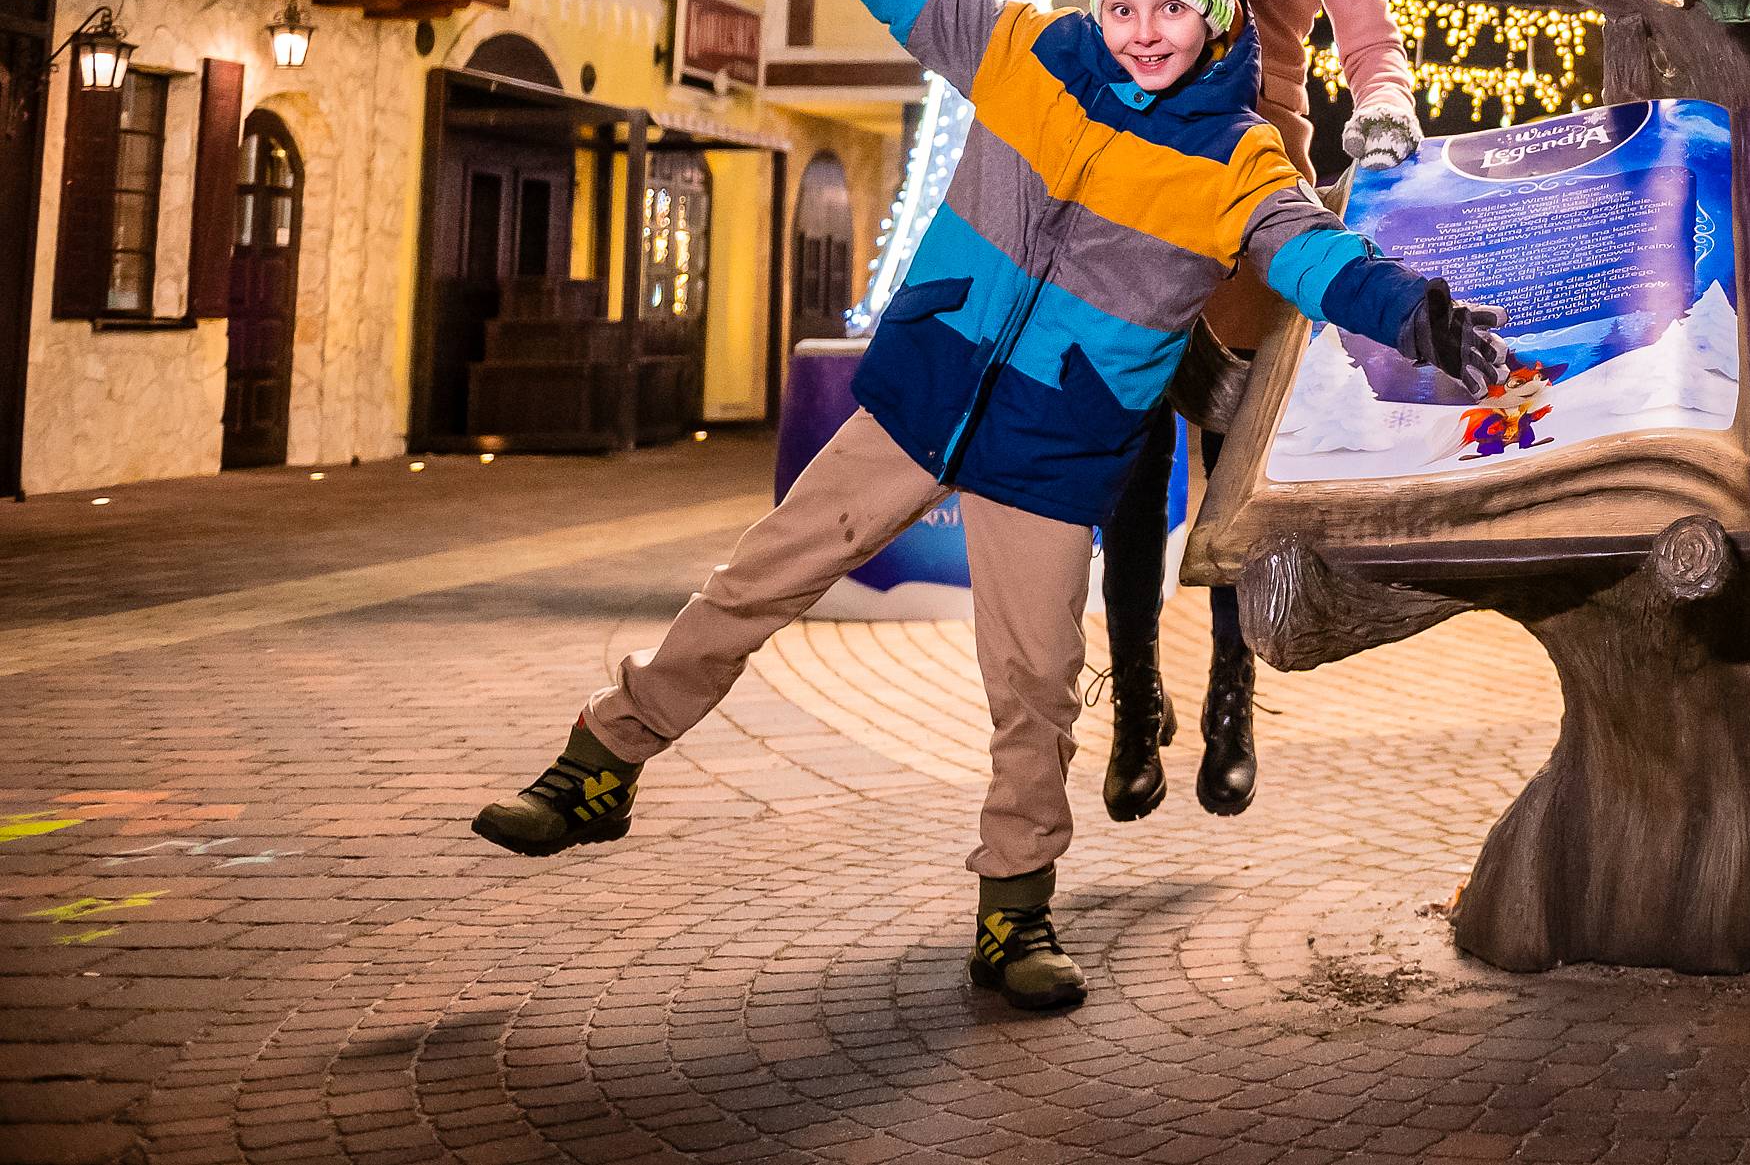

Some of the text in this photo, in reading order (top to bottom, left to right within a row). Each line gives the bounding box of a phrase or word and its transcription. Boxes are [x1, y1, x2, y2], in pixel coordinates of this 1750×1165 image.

[1515, 125, 1574, 142] Winter
[1462, 203, 1507, 215] Witajcie
[1522, 194, 1559, 205] Winter
[1600, 196, 1630, 205] wiele
[1427, 235, 1482, 248] magiczną
[1486, 228, 1522, 239] bramą
[1525, 217, 1580, 231] zostawcie
[1583, 206, 1637, 221] wszystkie
[1435, 222, 1462, 230] Czas
[1481, 211, 1526, 223] zabawie
[1530, 204, 1560, 214] Wam
[1486, 223, 1517, 233] Wam
[1520, 218, 1548, 227] będą
[1551, 210, 1590, 221] drodzy
[1403, 248, 1436, 256] Niech
[1439, 241, 1485, 254] podczas
[1487, 232, 1532, 245] zabawy
[1554, 218, 1607, 232] marszczą
[1421, 255, 1468, 266] naszymi
[1471, 244, 1528, 259] Skrzatami
[1591, 229, 1610, 237] ma
[1575, 240, 1616, 252] sobota,
[1441, 262, 1464, 271] gdy
[1466, 257, 1498, 267] pada,
[1580, 234, 1615, 245] taniec
[1464, 274, 1502, 284] śmiało
[1518, 265, 1544, 276] głąb
[1547, 258, 1582, 269] naszej
[1585, 247, 1634, 261] zimowej
[1637, 243, 1675, 251] krainy,
[1444, 271, 1485, 281] aruzele
[1494, 263, 1526, 275] psoty
[1529, 255, 1569, 267] zawsze
[1572, 250, 1592, 260] jest
[1467, 279, 1505, 290] chwilę
[1508, 273, 1535, 283] tutaj
[1539, 267, 1570, 277] Tobie
[1496, 284, 1545, 297] znajdzie
[1566, 276, 1584, 284] dla
[1489, 291, 1532, 304] atrakcji
[1556, 279, 1601, 292] małego
[1503, 299, 1531, 308] więc
[1532, 295, 1550, 305] już
[1553, 291, 1571, 299] ani
[1507, 305, 1533, 314] inter
[1537, 293, 1588, 308] Legendii
[1546, 300, 1587, 313] smutki
[1504, 303, 1600, 328] magiczny dzień!
